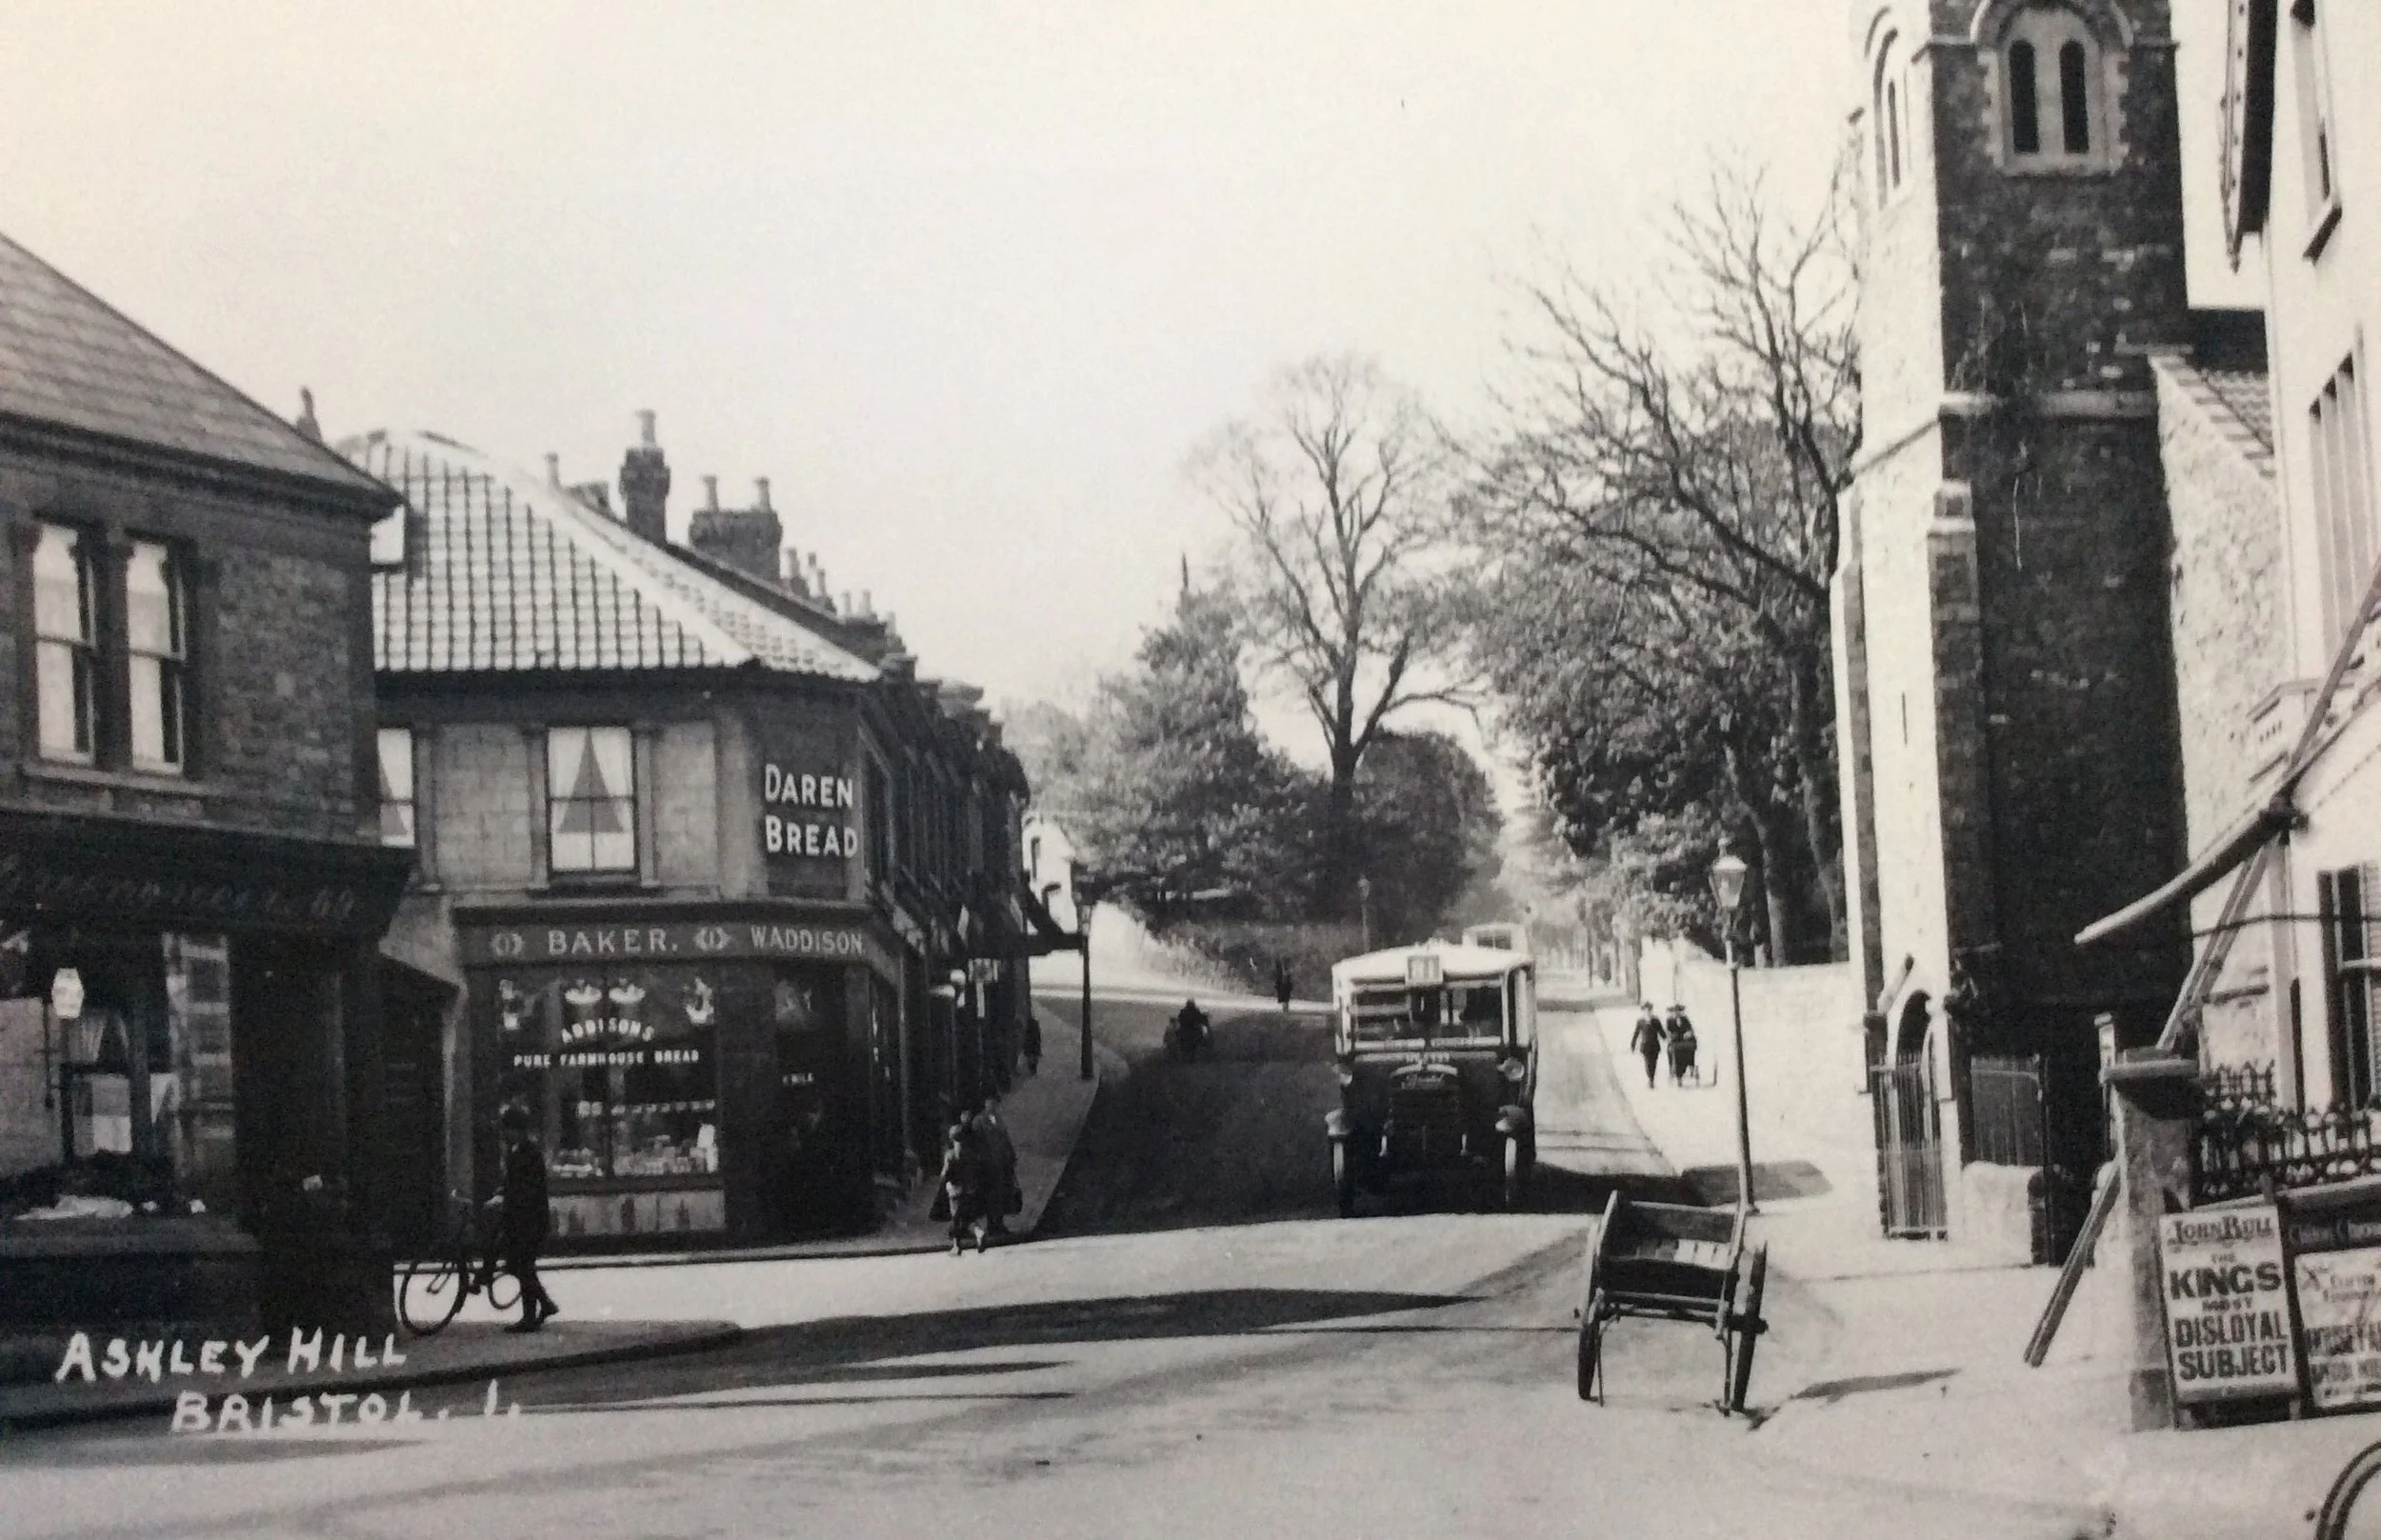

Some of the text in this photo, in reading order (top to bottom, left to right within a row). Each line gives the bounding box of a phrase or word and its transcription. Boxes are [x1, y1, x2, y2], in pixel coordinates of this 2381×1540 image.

[765, 763, 853, 809] DAREN
[765, 814, 858, 858] BREAD
[548, 928, 678, 954] BAKER.
[513, 1050, 699, 1068] PURE FARMHOUSE BREAD
[2169, 1262, 2282, 1300] KINGS
[2174, 1310, 2291, 1348] DISLOYAL
[2178, 1343, 2289, 1381] SUBJECT
